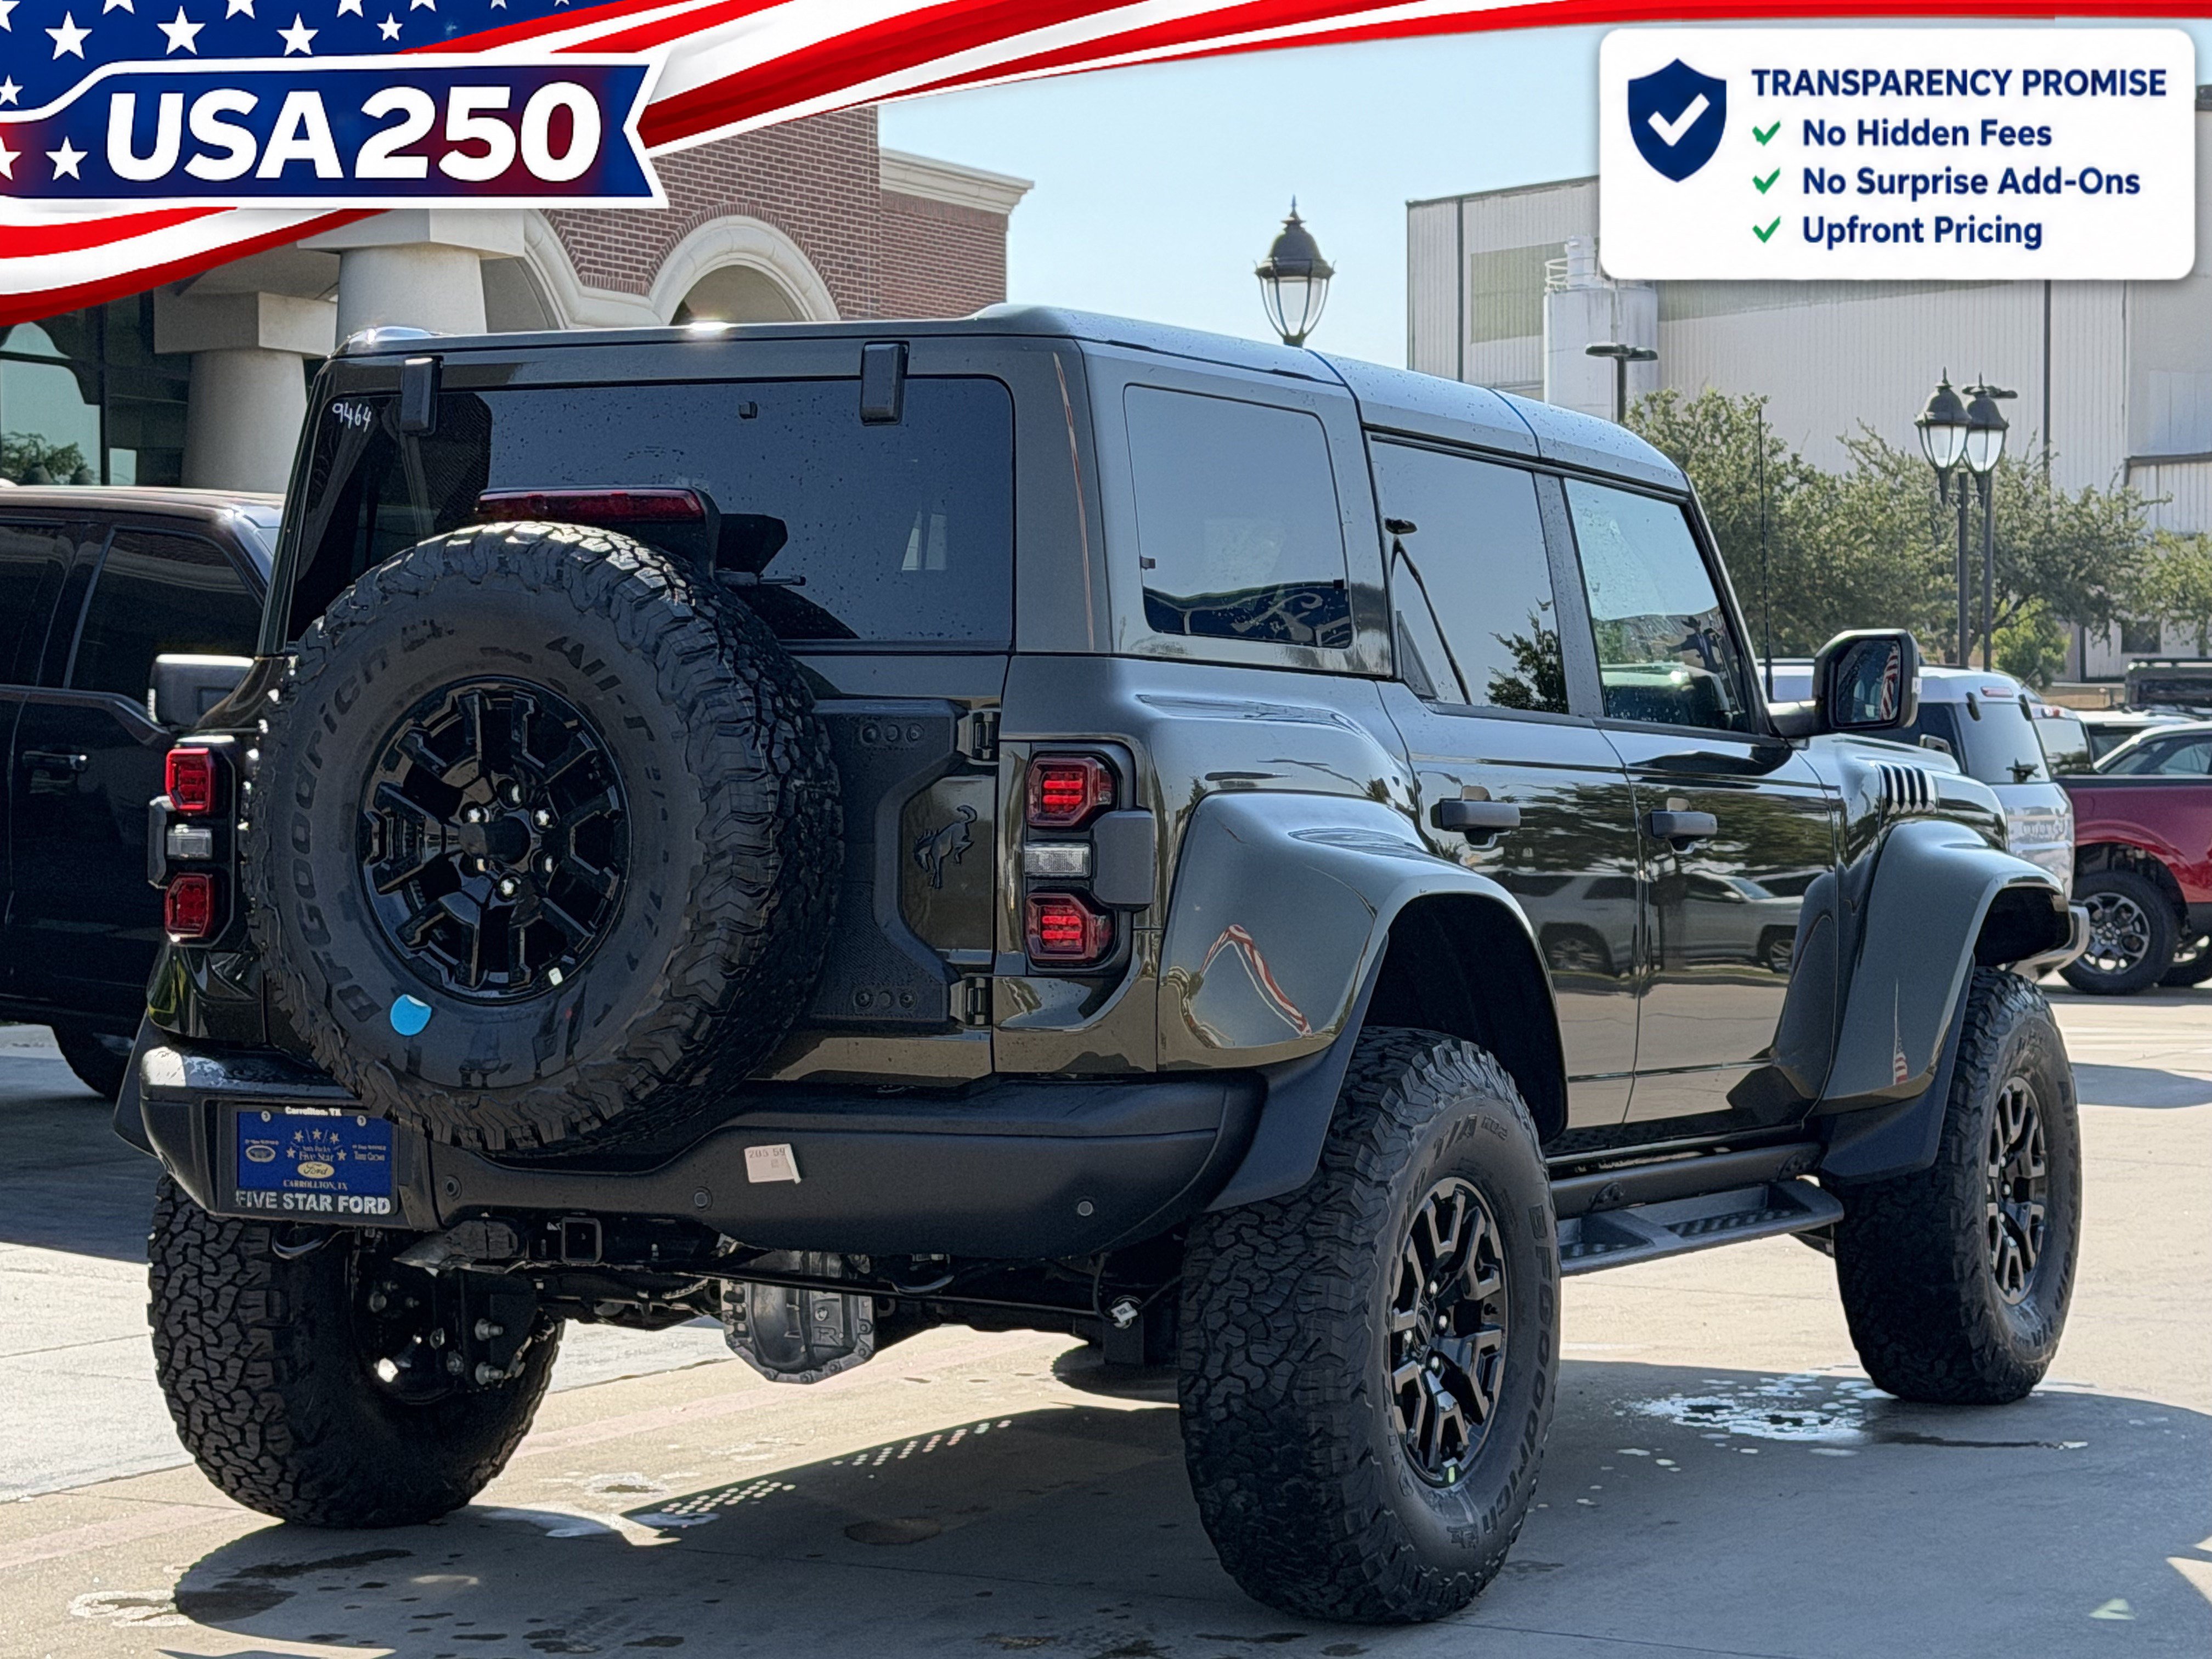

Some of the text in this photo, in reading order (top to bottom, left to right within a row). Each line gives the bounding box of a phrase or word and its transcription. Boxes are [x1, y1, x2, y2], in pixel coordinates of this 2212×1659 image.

[332, 402, 372, 433] 9464
[303, 1163, 329, 1175] Ford
[235, 1190, 391, 1215] FIVE STAR FORD
